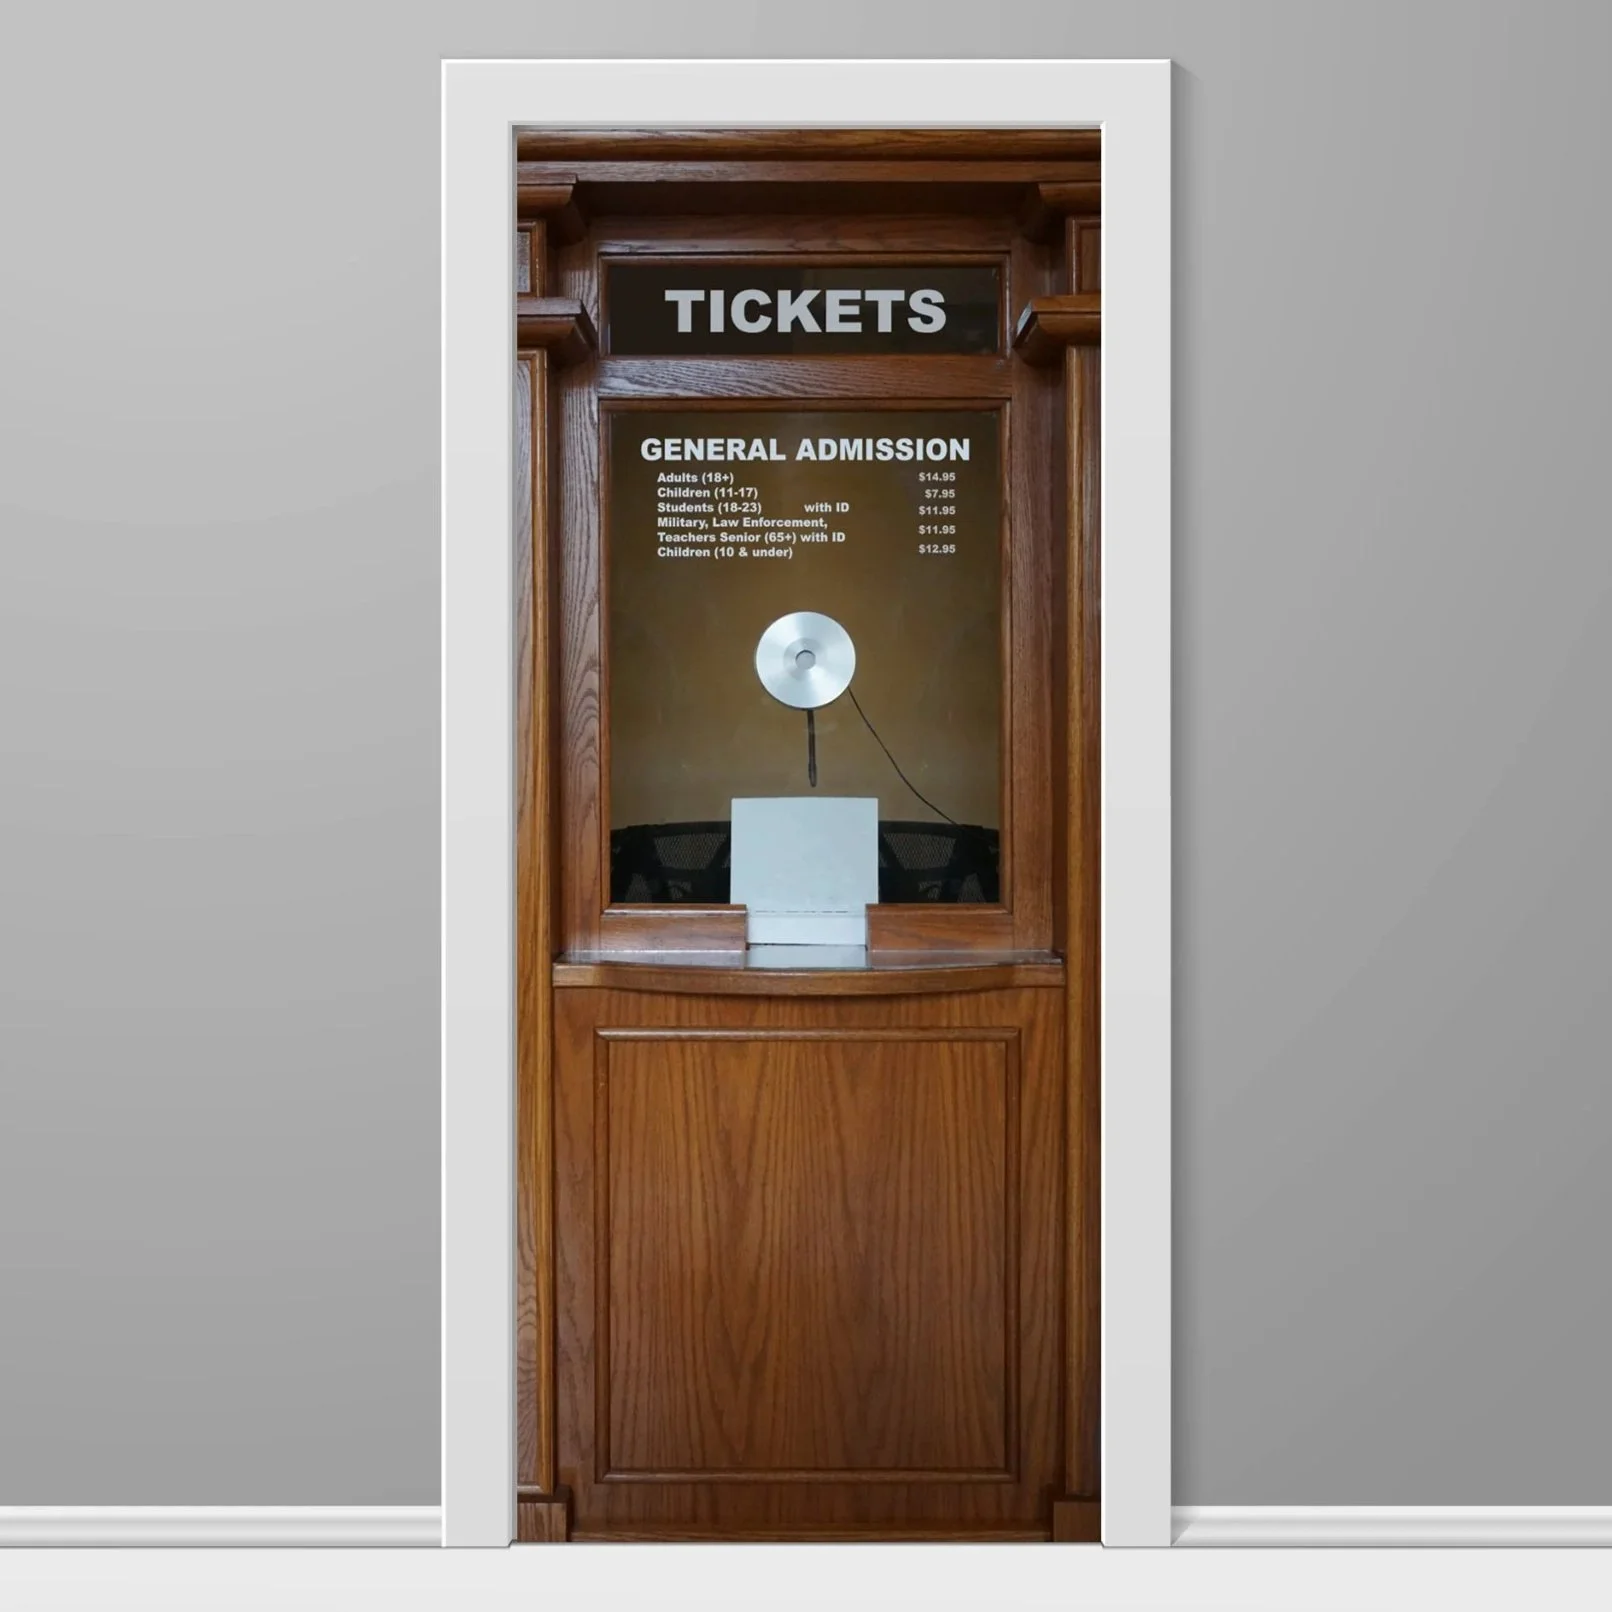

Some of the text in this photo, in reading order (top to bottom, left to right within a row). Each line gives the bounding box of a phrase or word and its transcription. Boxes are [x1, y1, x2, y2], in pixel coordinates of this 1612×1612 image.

[665, 290, 946, 333] TICKETS
[641, 438, 969, 461] GENERAL ADMISSION
[657, 472, 734, 485] Adults (18+)
[919, 472, 955, 481] $14.95
[657, 487, 758, 500] Children (11-17)
[925, 489, 955, 499] $7.95
[657, 502, 849, 515] Students (18-23) with ID
[919, 506, 955, 515] $11.95
[658, 517, 828, 530] Military, Law Enforcement,
[919, 525, 955, 534] $11.95
[657, 532, 846, 544] Teachers Senior (65+) with ID
[657, 546, 793, 560] Children (10 & under)
[919, 544, 955, 554] $12.95
